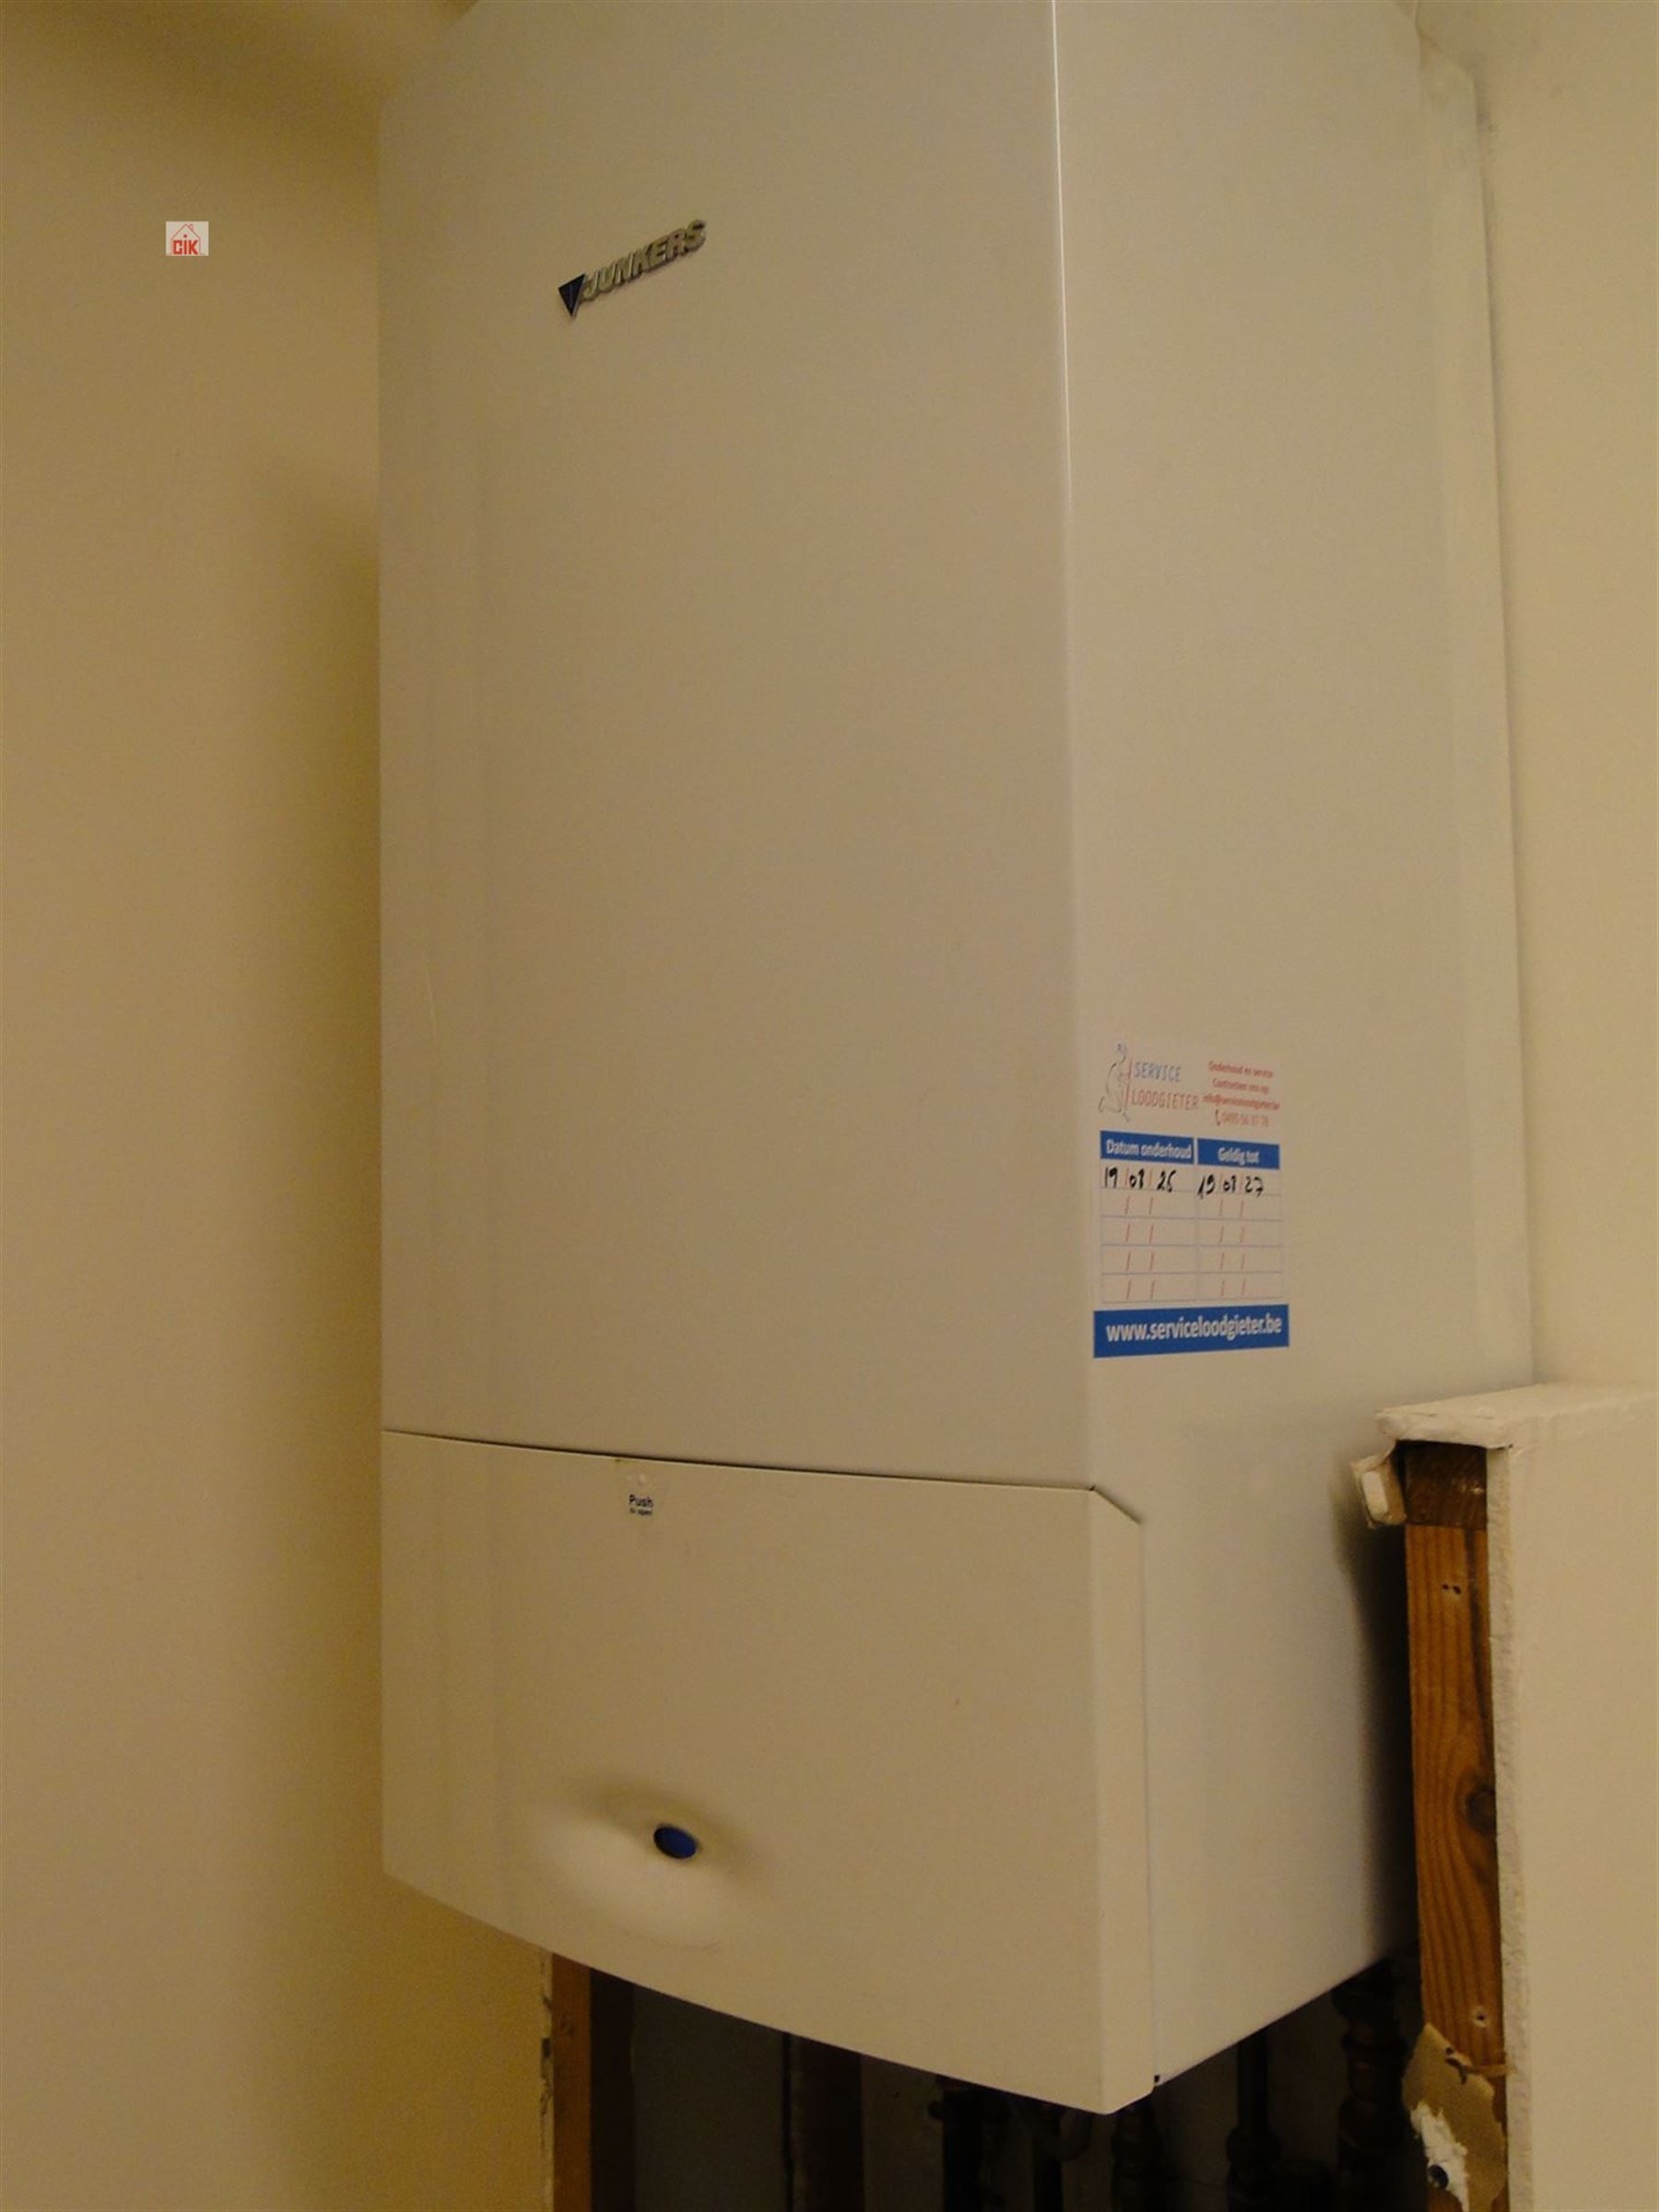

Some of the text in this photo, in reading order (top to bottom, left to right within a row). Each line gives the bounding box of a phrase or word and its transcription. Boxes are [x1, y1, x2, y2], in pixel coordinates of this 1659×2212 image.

[581, 219, 706, 302] JUNKERS
[1134, 1061, 1182, 1083] SERVICE
[1132, 1089, 1198, 1111] LOODGIETER
[1106, 1139, 1193, 1159] Datum onderhoud
[1218, 1147, 1261, 1165] Geldig tot
[1106, 1312, 1282, 1342] www.serviceloodgieter.be
[629, 1493, 653, 1508] Push
